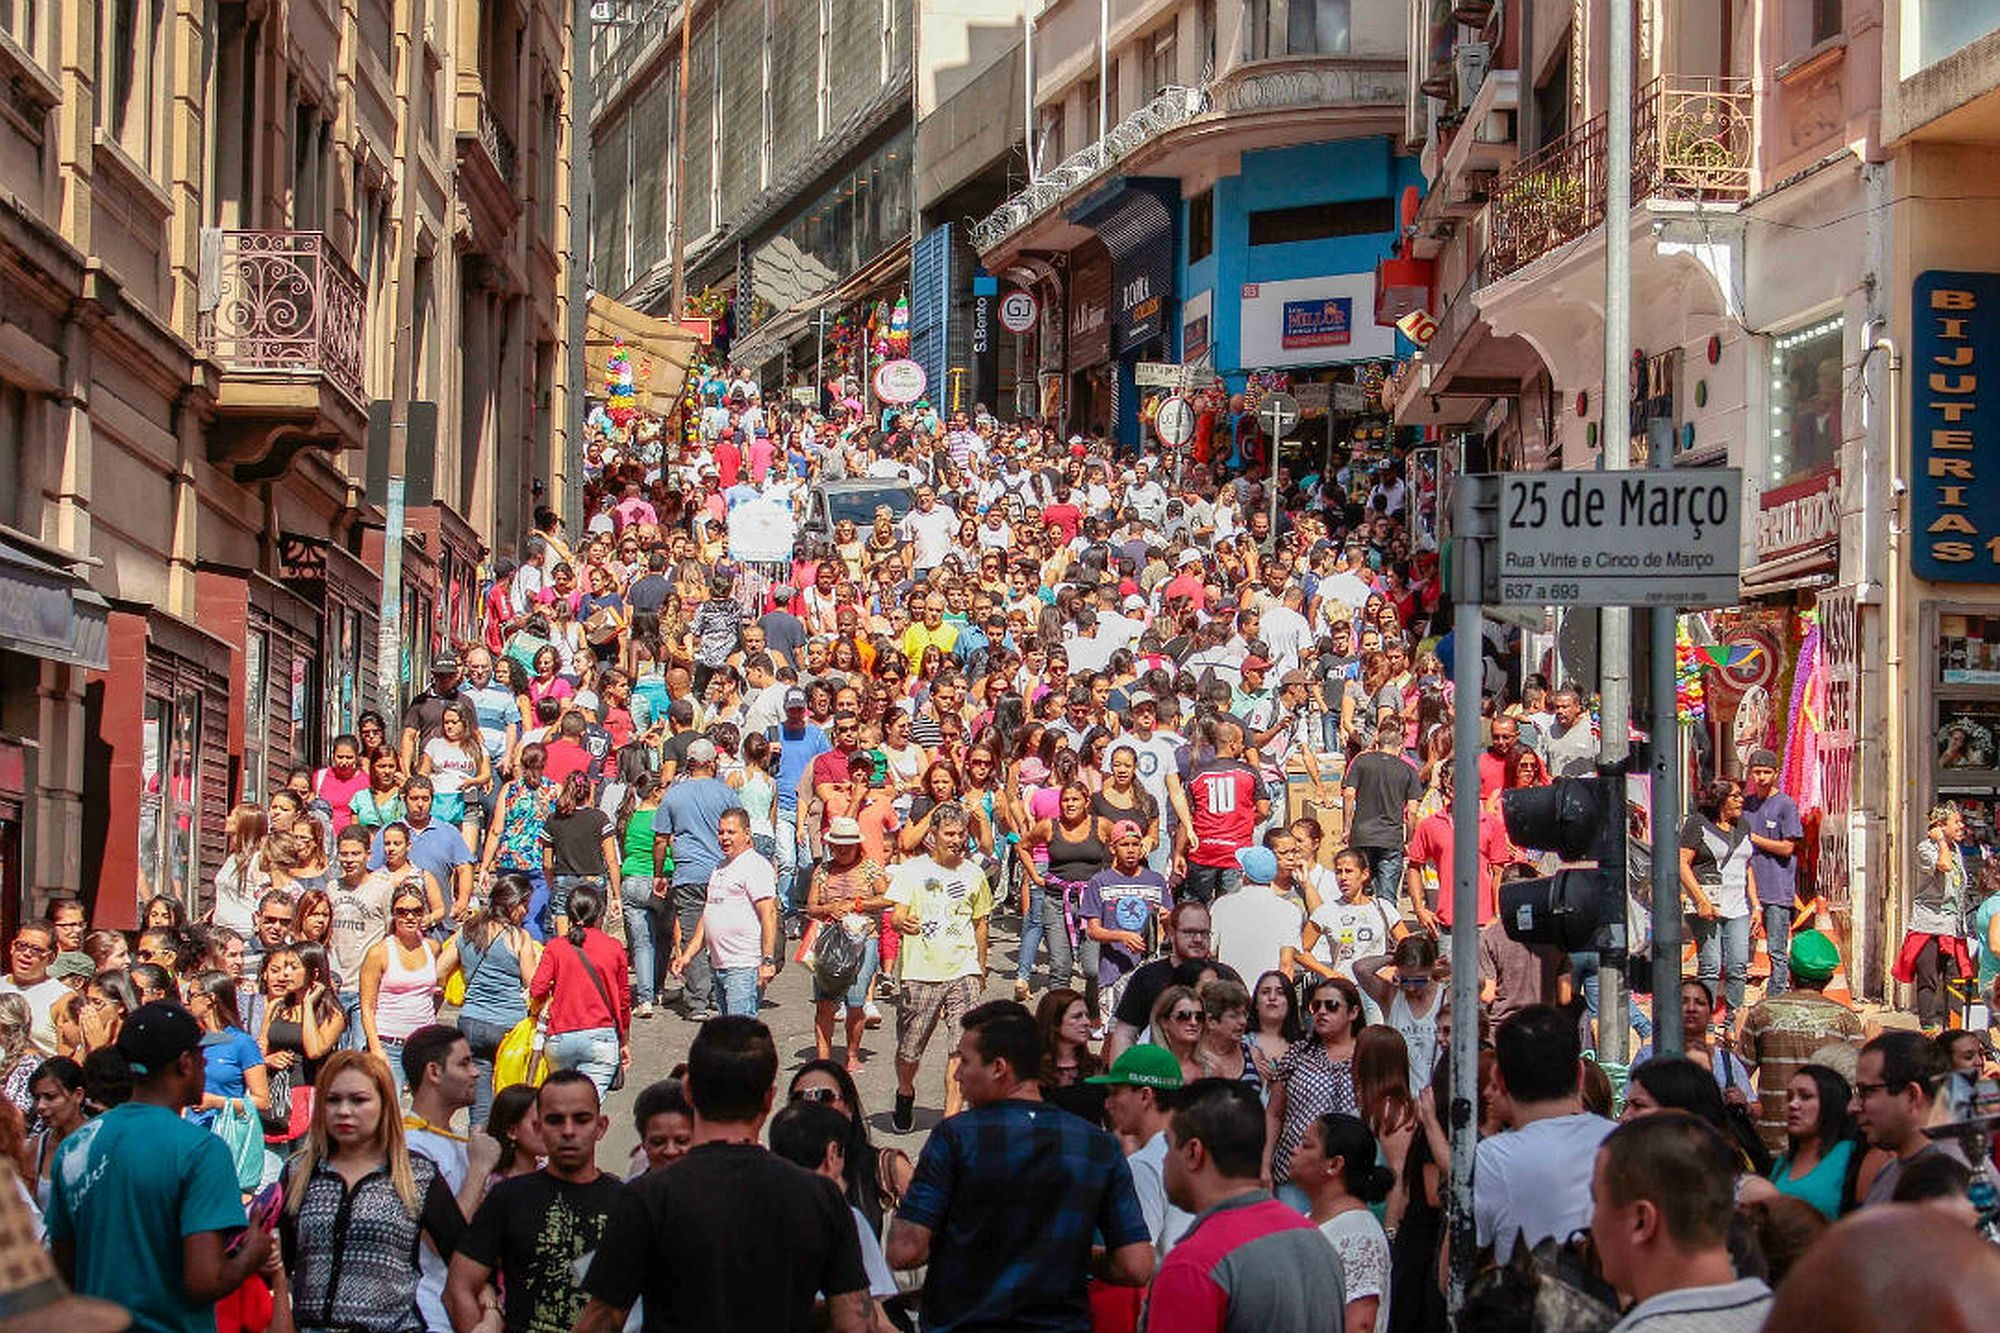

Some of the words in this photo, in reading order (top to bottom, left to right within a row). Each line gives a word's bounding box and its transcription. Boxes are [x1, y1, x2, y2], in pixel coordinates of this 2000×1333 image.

[1927, 289, 1978, 563] BIJUTERIAS
[1509, 481, 1547, 529] 25
[1562, 477, 1605, 527] de
[1621, 478, 1729, 540] Março
[1506, 552, 1535, 568] Rua
[1539, 551, 1577, 568] Vinte
[1582, 554, 1592, 567] e
[1595, 551, 1640, 568] Cinco
[1643, 551, 1662, 567] de
[1666, 551, 1714, 571] Março
[1505, 583, 1532, 600] 637
[1536, 587, 1546, 600] a
[1550, 583, 1580, 600] 693
[1204, 777, 1235, 814] 10
